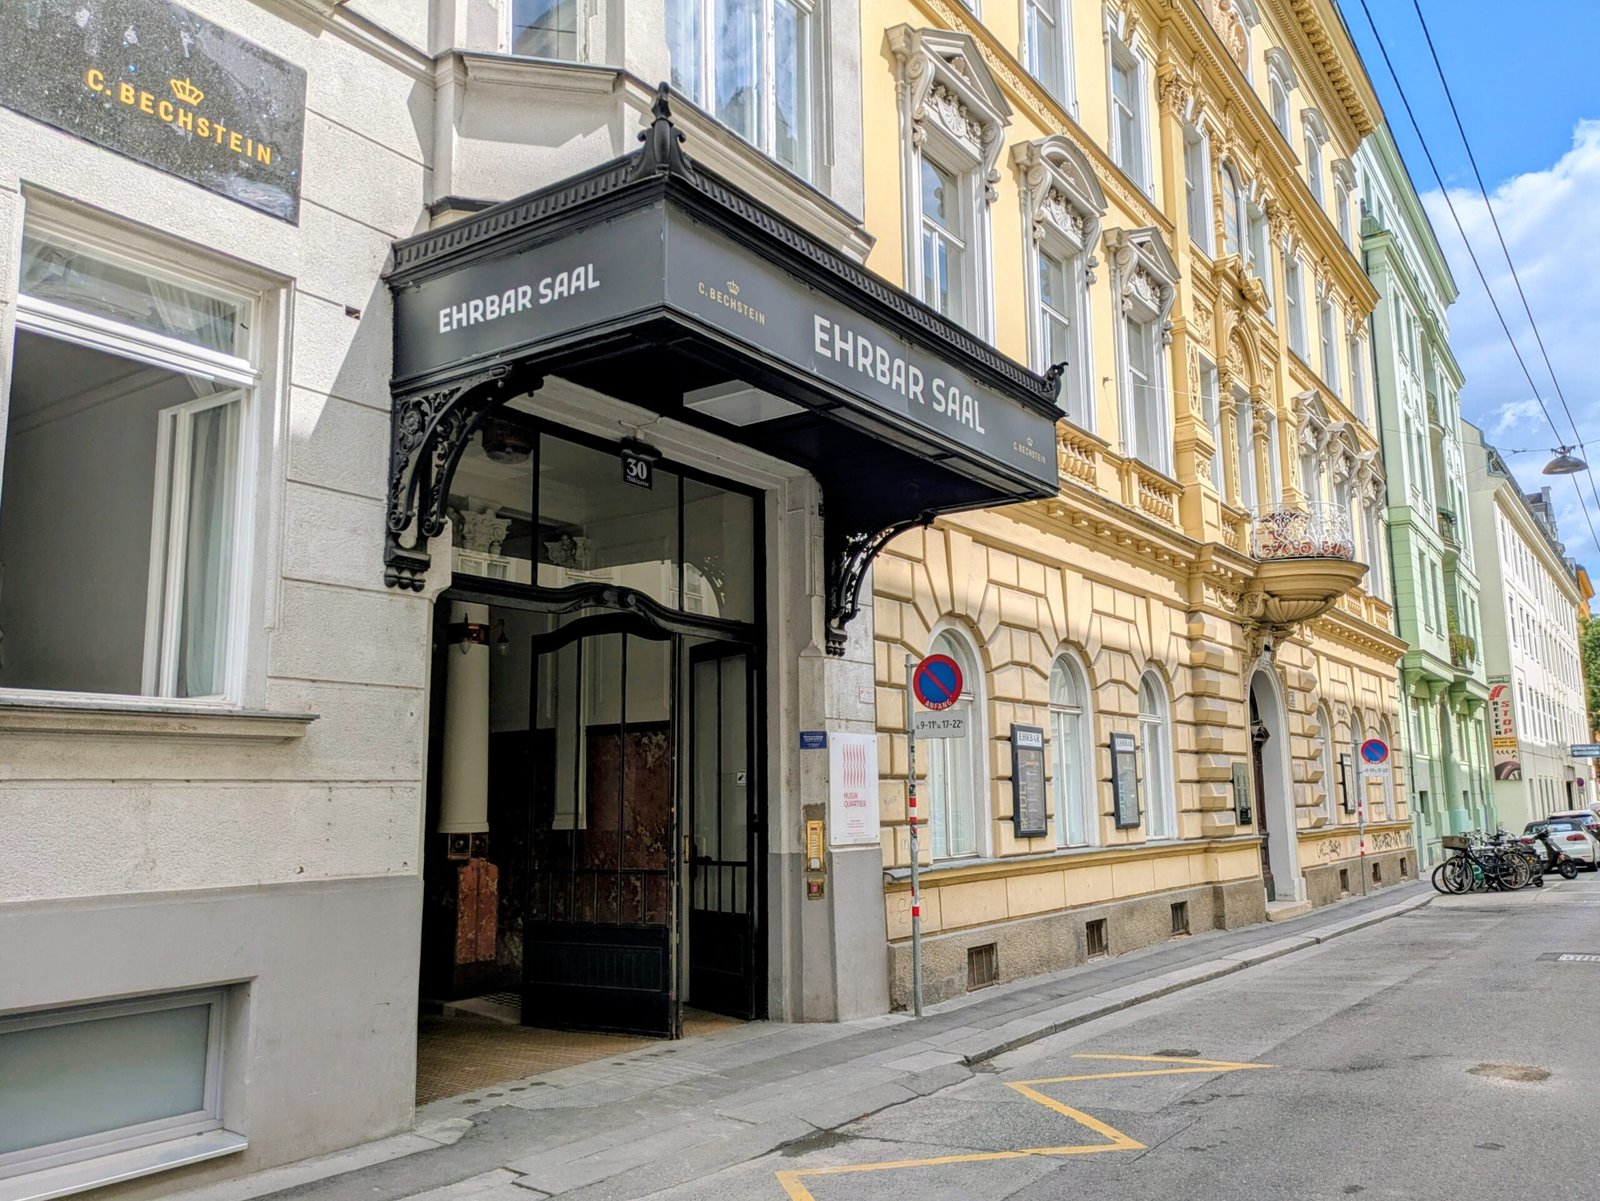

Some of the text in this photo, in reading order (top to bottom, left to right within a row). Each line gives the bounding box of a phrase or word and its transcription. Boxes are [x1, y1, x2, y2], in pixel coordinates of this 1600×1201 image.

[86, 68, 272, 166] C. BECHSTEIN
[439, 263, 600, 334] EHRBAR SAAL
[698, 281, 766, 326] C. BECHSTEIN
[813, 314, 986, 435] EHRBAR SAAL
[626, 457, 648, 479] 30
[924, 698, 952, 710] ANFANG
[1492, 701, 1502, 735] REIFEN
[1501, 701, 1513, 734] STOP
[843, 792, 859, 800] MUSIK
[843, 800, 867, 808] QUARTIER
